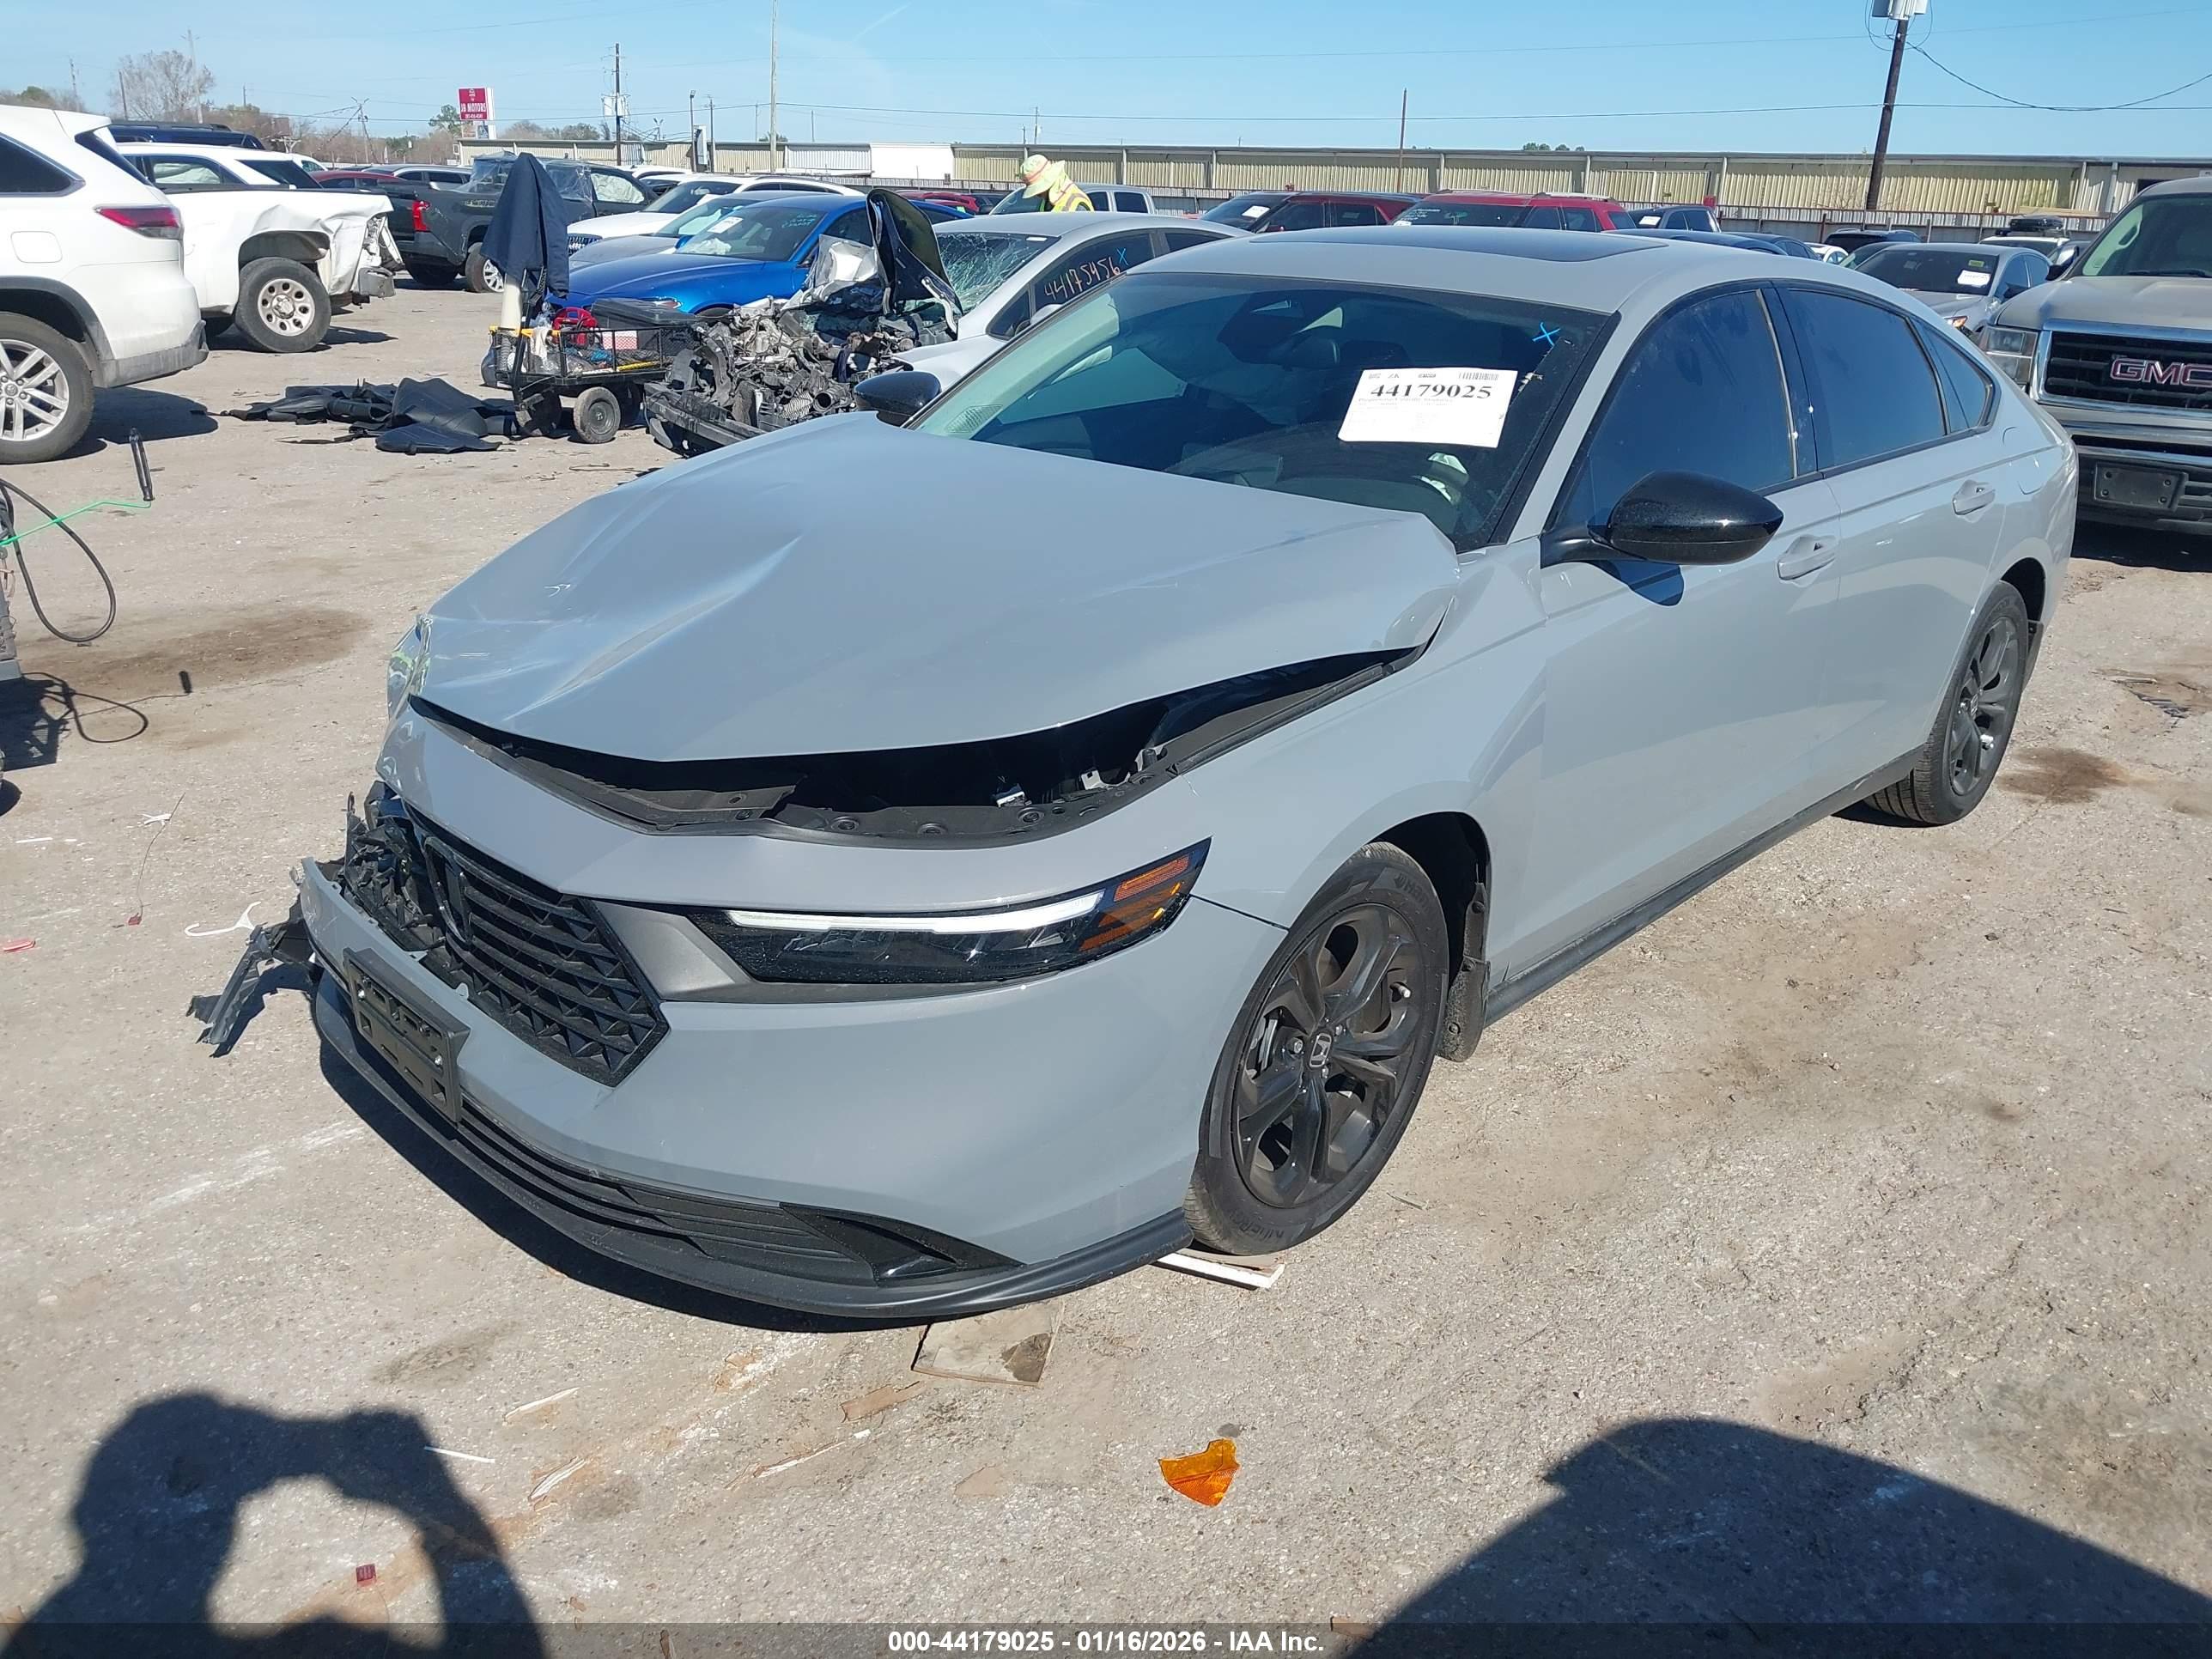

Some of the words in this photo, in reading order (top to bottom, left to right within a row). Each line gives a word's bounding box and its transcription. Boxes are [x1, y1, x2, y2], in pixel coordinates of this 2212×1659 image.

[467, 103, 487, 112] MOTORS
[1044, 256, 1121, 301] 44175456
[2110, 357, 2212, 388] GMC
[1370, 384, 1492, 399] 44179025
